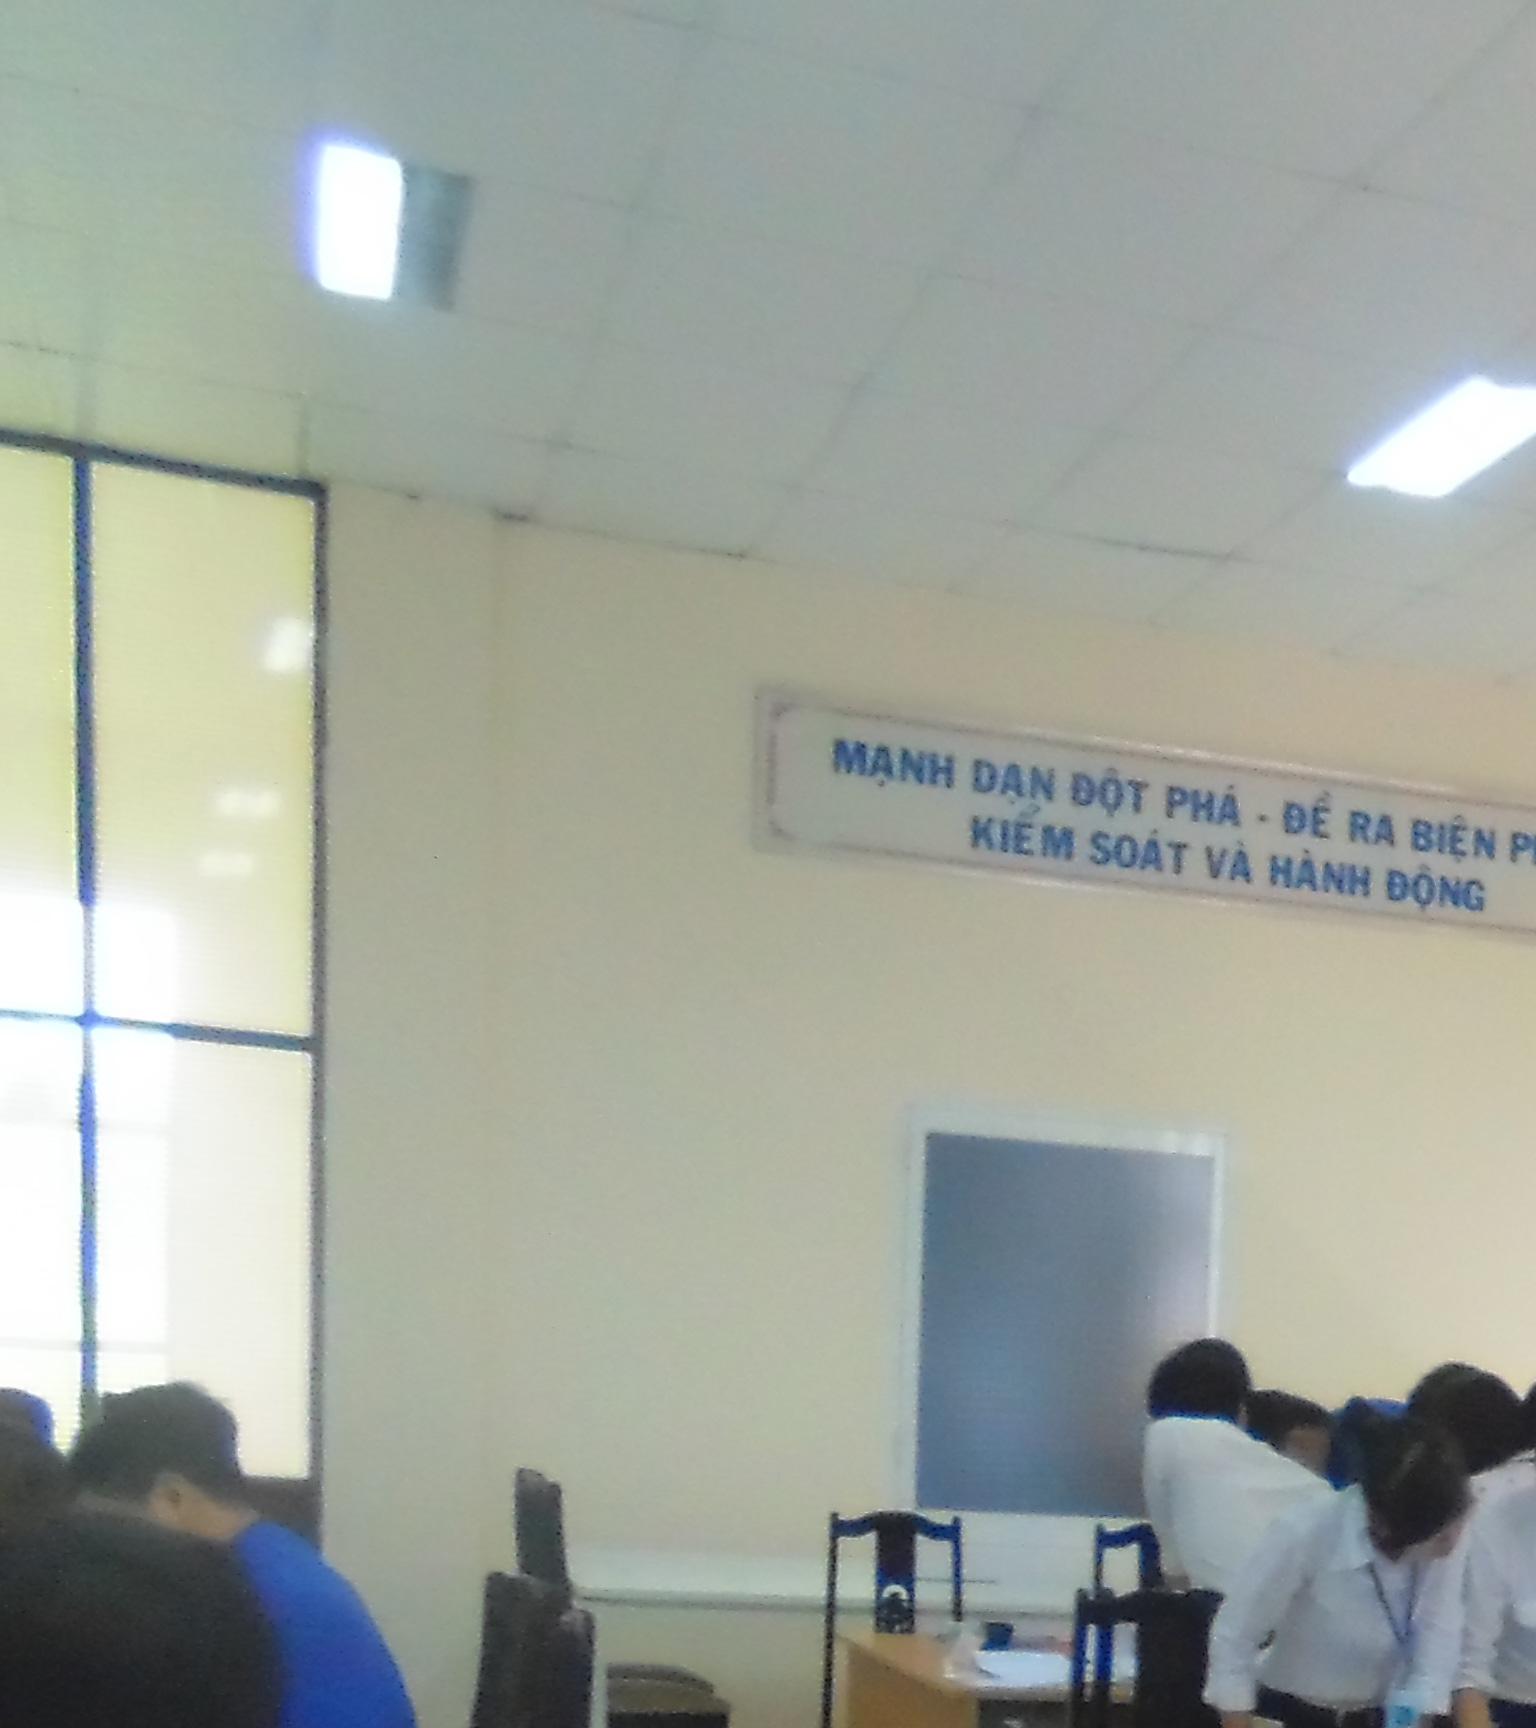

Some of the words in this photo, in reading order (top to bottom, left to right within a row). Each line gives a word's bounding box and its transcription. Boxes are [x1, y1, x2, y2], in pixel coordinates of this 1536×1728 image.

[832, 738, 956, 789] MẠNH
[972, 758, 1056, 805] DẠN
[1070, 768, 1149, 818] ĐỘT
[1165, 783, 1241, 828] PHÁ
[1348, 809, 1396, 848] RA
[1410, 813, 1497, 863] BIỆN
[968, 802, 1076, 862] KIỂM
[1089, 828, 1192, 876] SOÁT
[1204, 840, 1253, 884] VÀ
[1268, 847, 1372, 898] HÀNH
[1385, 863, 1486, 913] ĐỘNG
